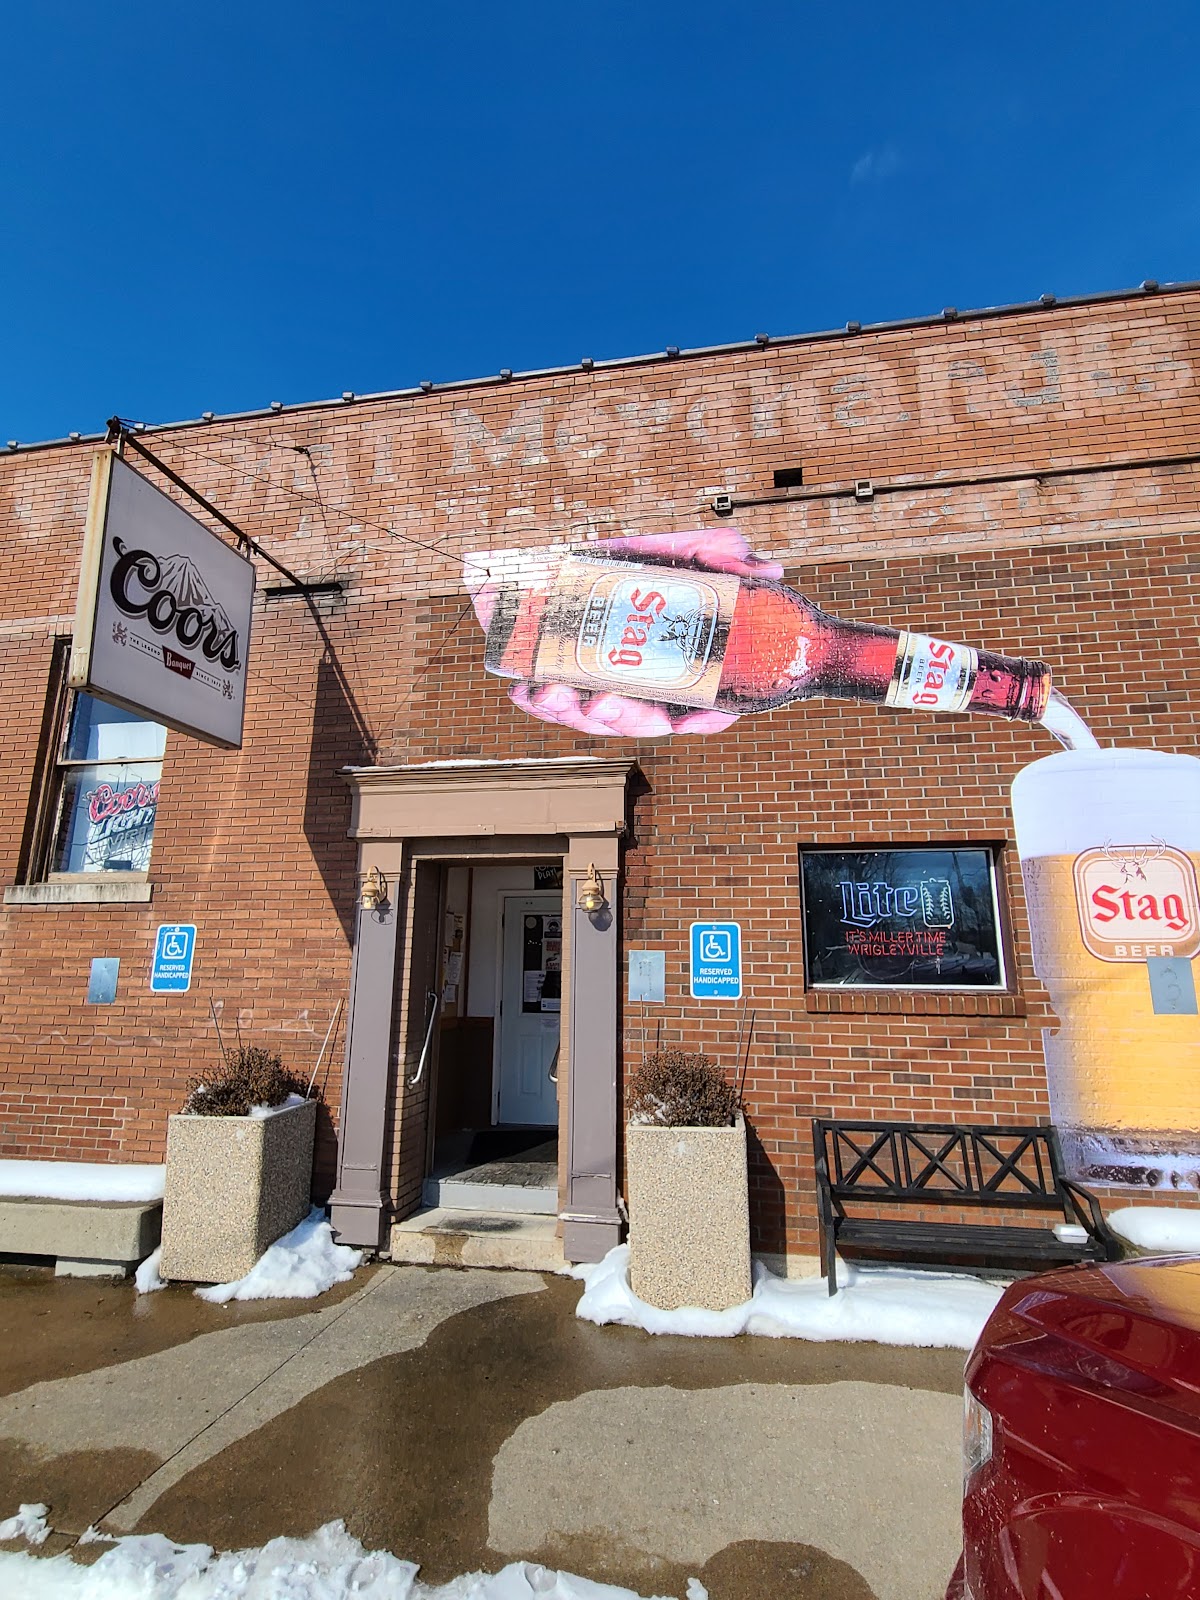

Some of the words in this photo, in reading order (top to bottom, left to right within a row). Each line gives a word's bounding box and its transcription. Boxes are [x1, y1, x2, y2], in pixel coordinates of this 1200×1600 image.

[110, 536, 241, 673] Coors
[584, 596, 605, 647] BEER
[608, 587, 667, 667] Stag
[130, 636, 139, 645] THE
[141, 642, 161, 656] LEGEND
[166, 652, 192, 671] Banquet
[915, 658, 926, 683] BEER
[912, 641, 955, 705] Stag
[838, 881, 918, 928] Lite
[1092, 884, 1189, 931] Stag
[845, 929, 866, 943] IT'S
[869, 931, 913, 943] MILLER
[915, 931, 946, 943] TIME
[848, 943, 944, 956] WRIGLEYVILLE
[1114, 945, 1175, 957] BEER
[693, 976, 739, 985] HANDICAPPED
[699, 967, 733, 976] RESERVED
